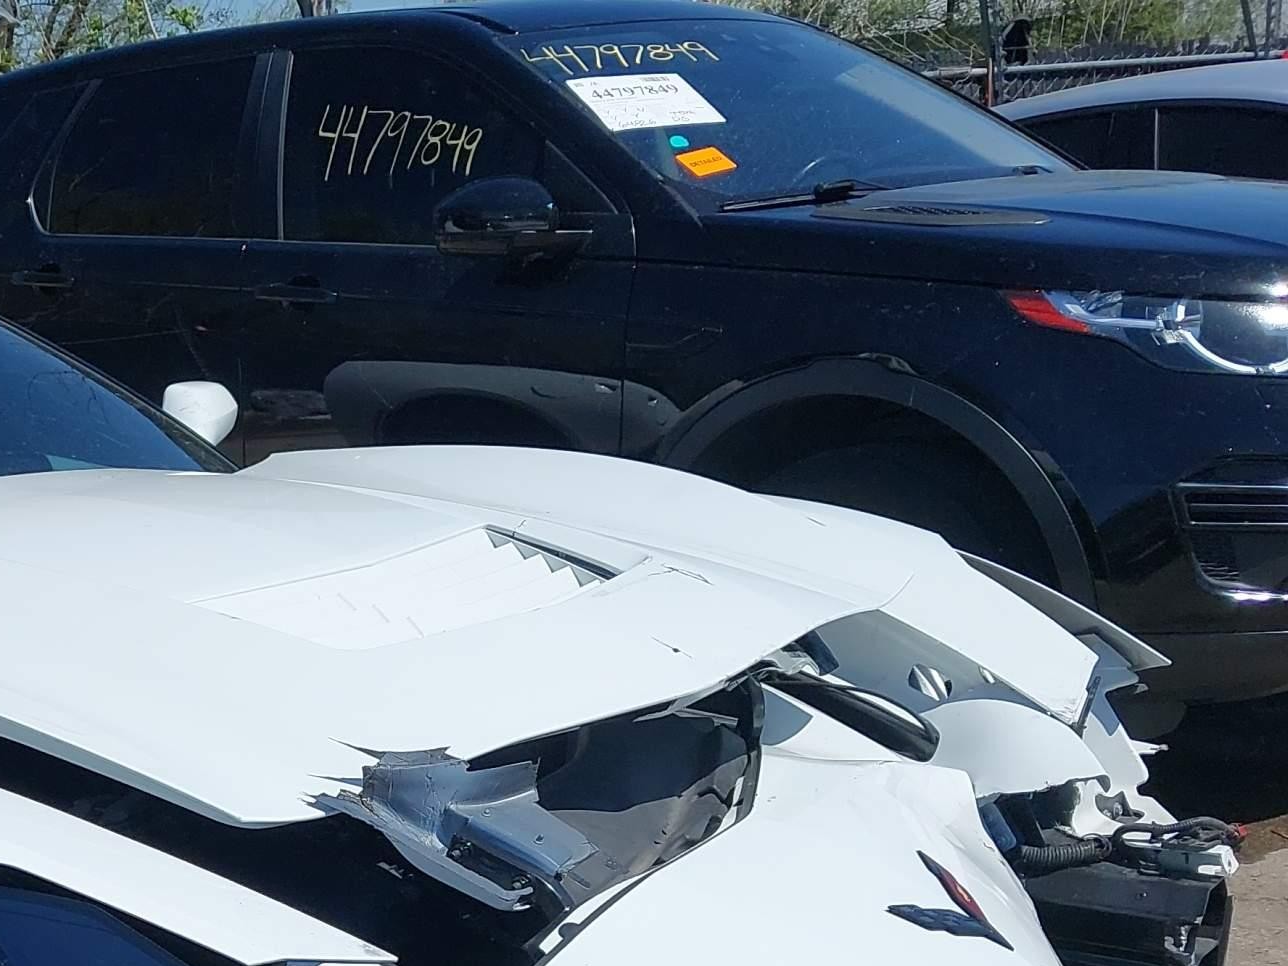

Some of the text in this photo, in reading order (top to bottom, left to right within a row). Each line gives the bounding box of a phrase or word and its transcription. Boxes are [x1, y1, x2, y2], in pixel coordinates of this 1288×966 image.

[520, 41, 720, 76] 44797849
[591, 83, 679, 99] 44797849
[318, 104, 483, 181] 44797849
